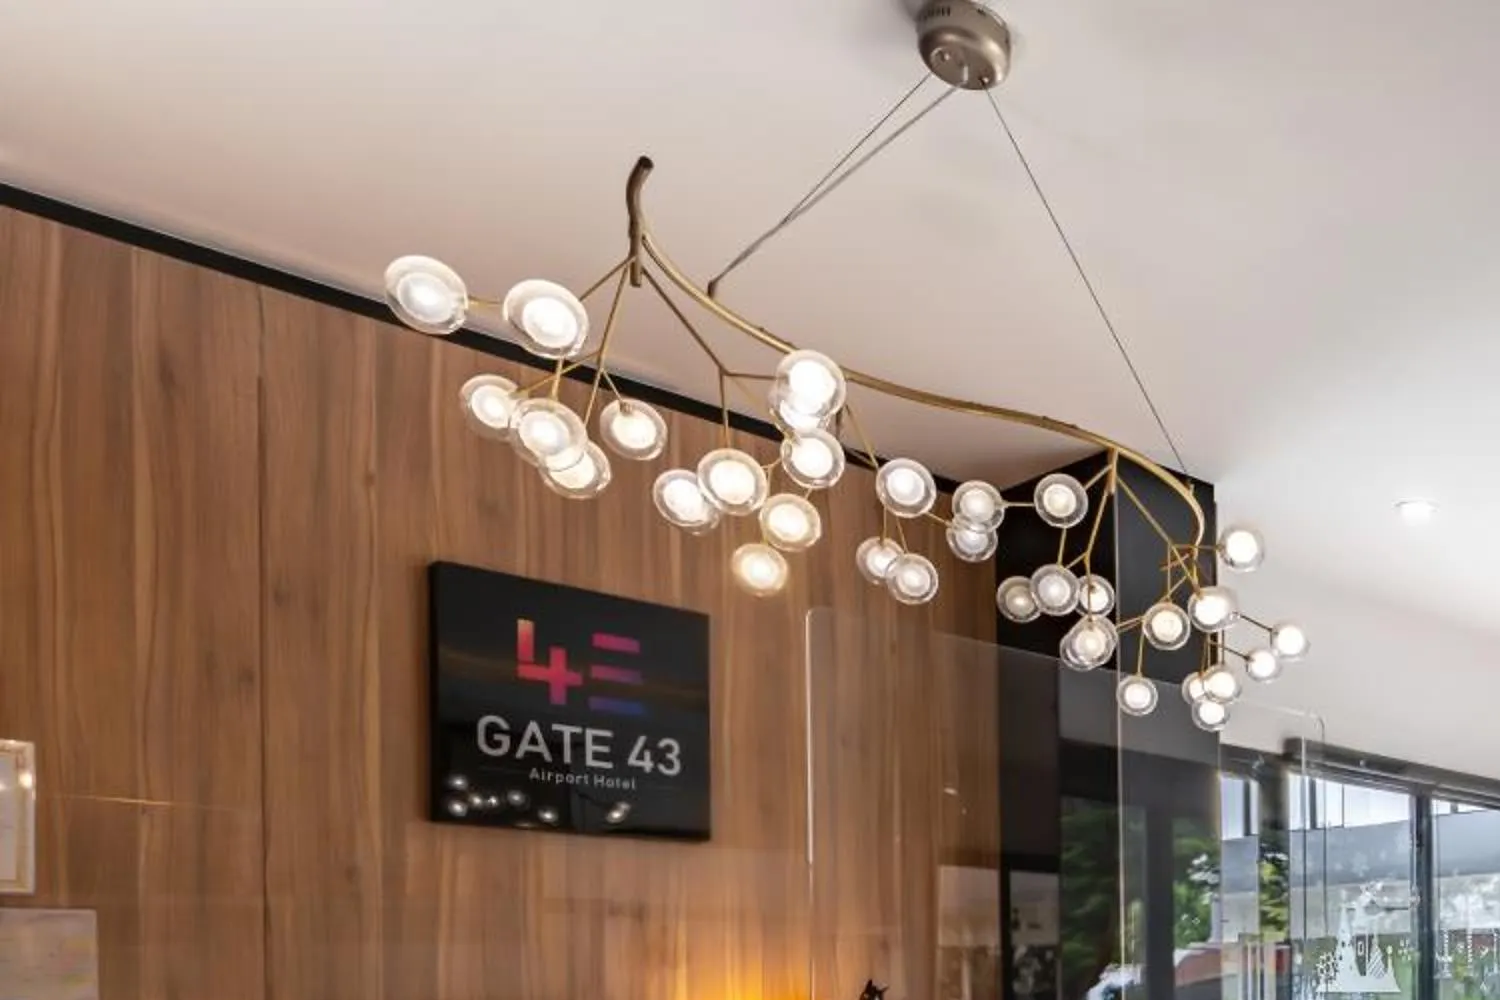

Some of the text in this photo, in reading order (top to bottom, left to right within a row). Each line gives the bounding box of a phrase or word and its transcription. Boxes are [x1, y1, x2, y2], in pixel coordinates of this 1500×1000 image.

[476, 714, 682, 777] GATE 43
[528, 767, 636, 790] Airport Hotel
